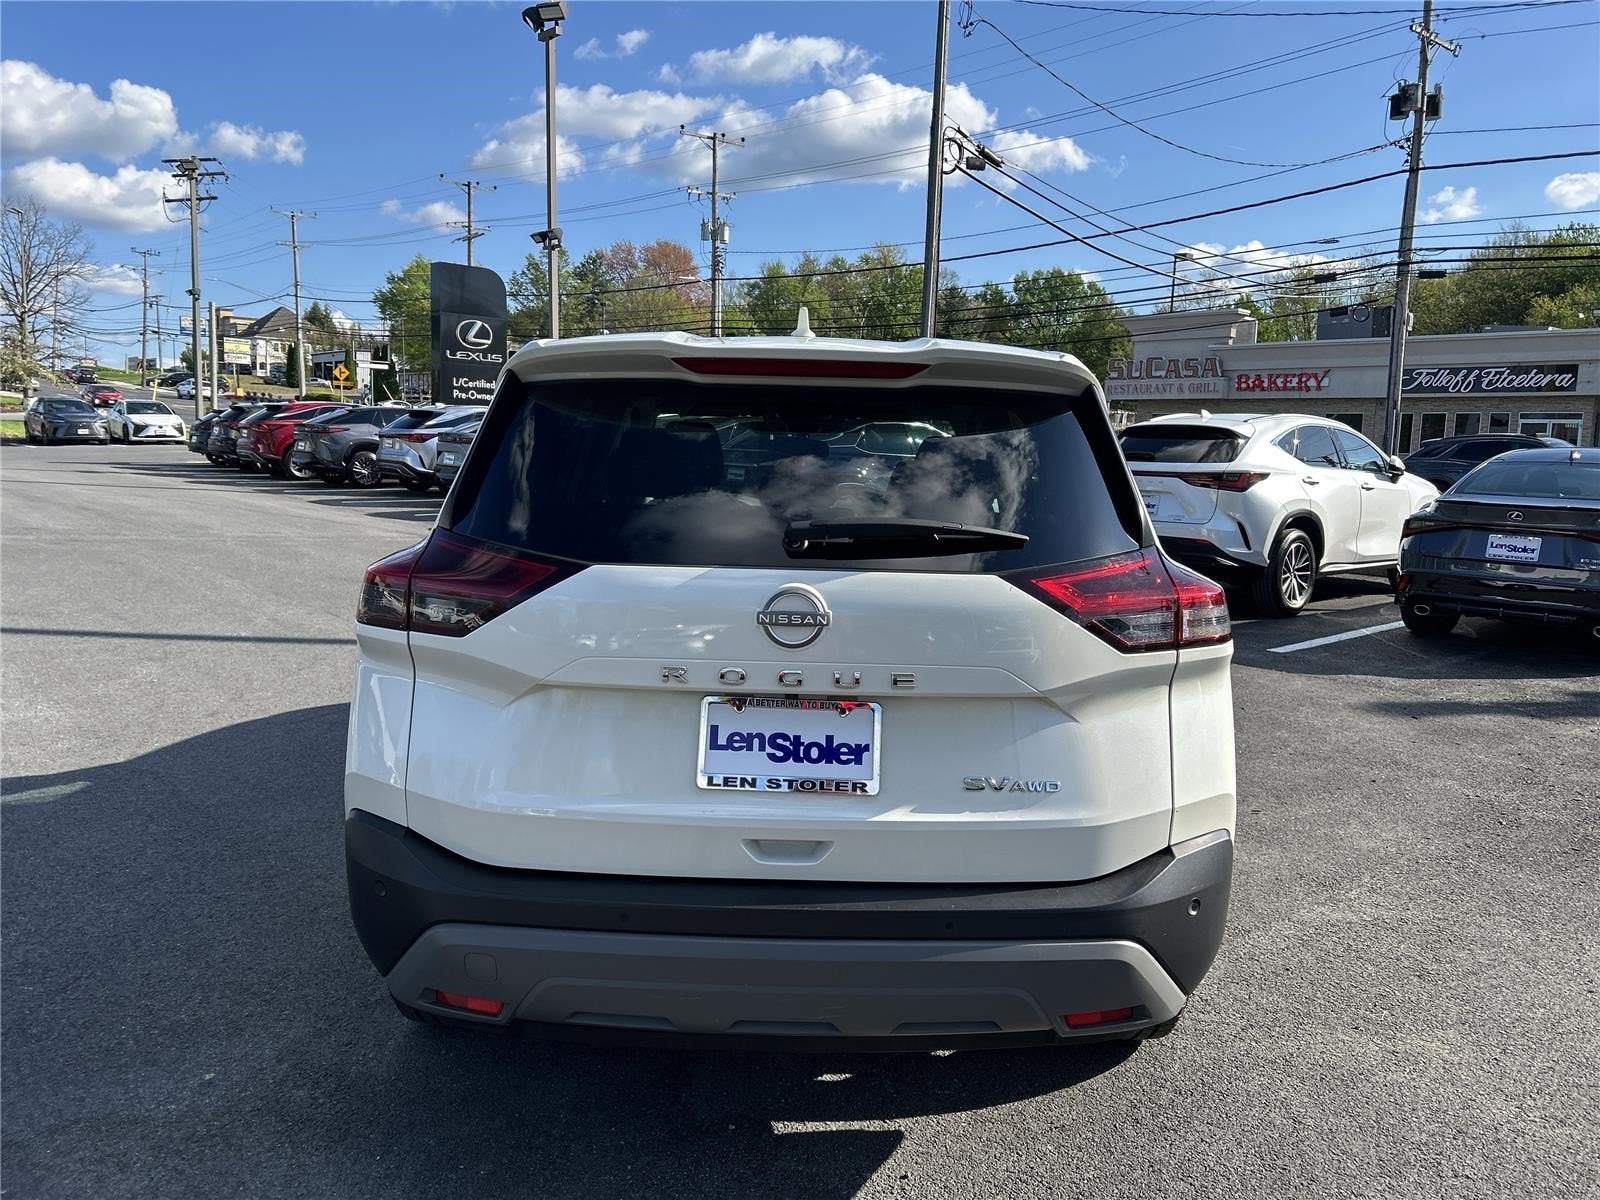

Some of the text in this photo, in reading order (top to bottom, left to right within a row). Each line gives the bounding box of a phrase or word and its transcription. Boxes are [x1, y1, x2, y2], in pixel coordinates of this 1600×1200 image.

[446, 349, 502, 362] LEXUS
[453, 376, 496, 389] L/Certified
[1236, 368, 1331, 392] BAKERY
[1481, 367, 1576, 390] Etcetera
[1107, 382, 1219, 396] RESTAURANT & GRILL
[759, 613, 828, 626] NISSAN
[661, 665, 918, 690] ROGUE
[755, 698, 786, 708] BETTER
[787, 700, 804, 709] WAY
[806, 701, 818, 709] TO
[820, 701, 836, 710] BUY
[706, 775, 870, 794] LEN STOLER
